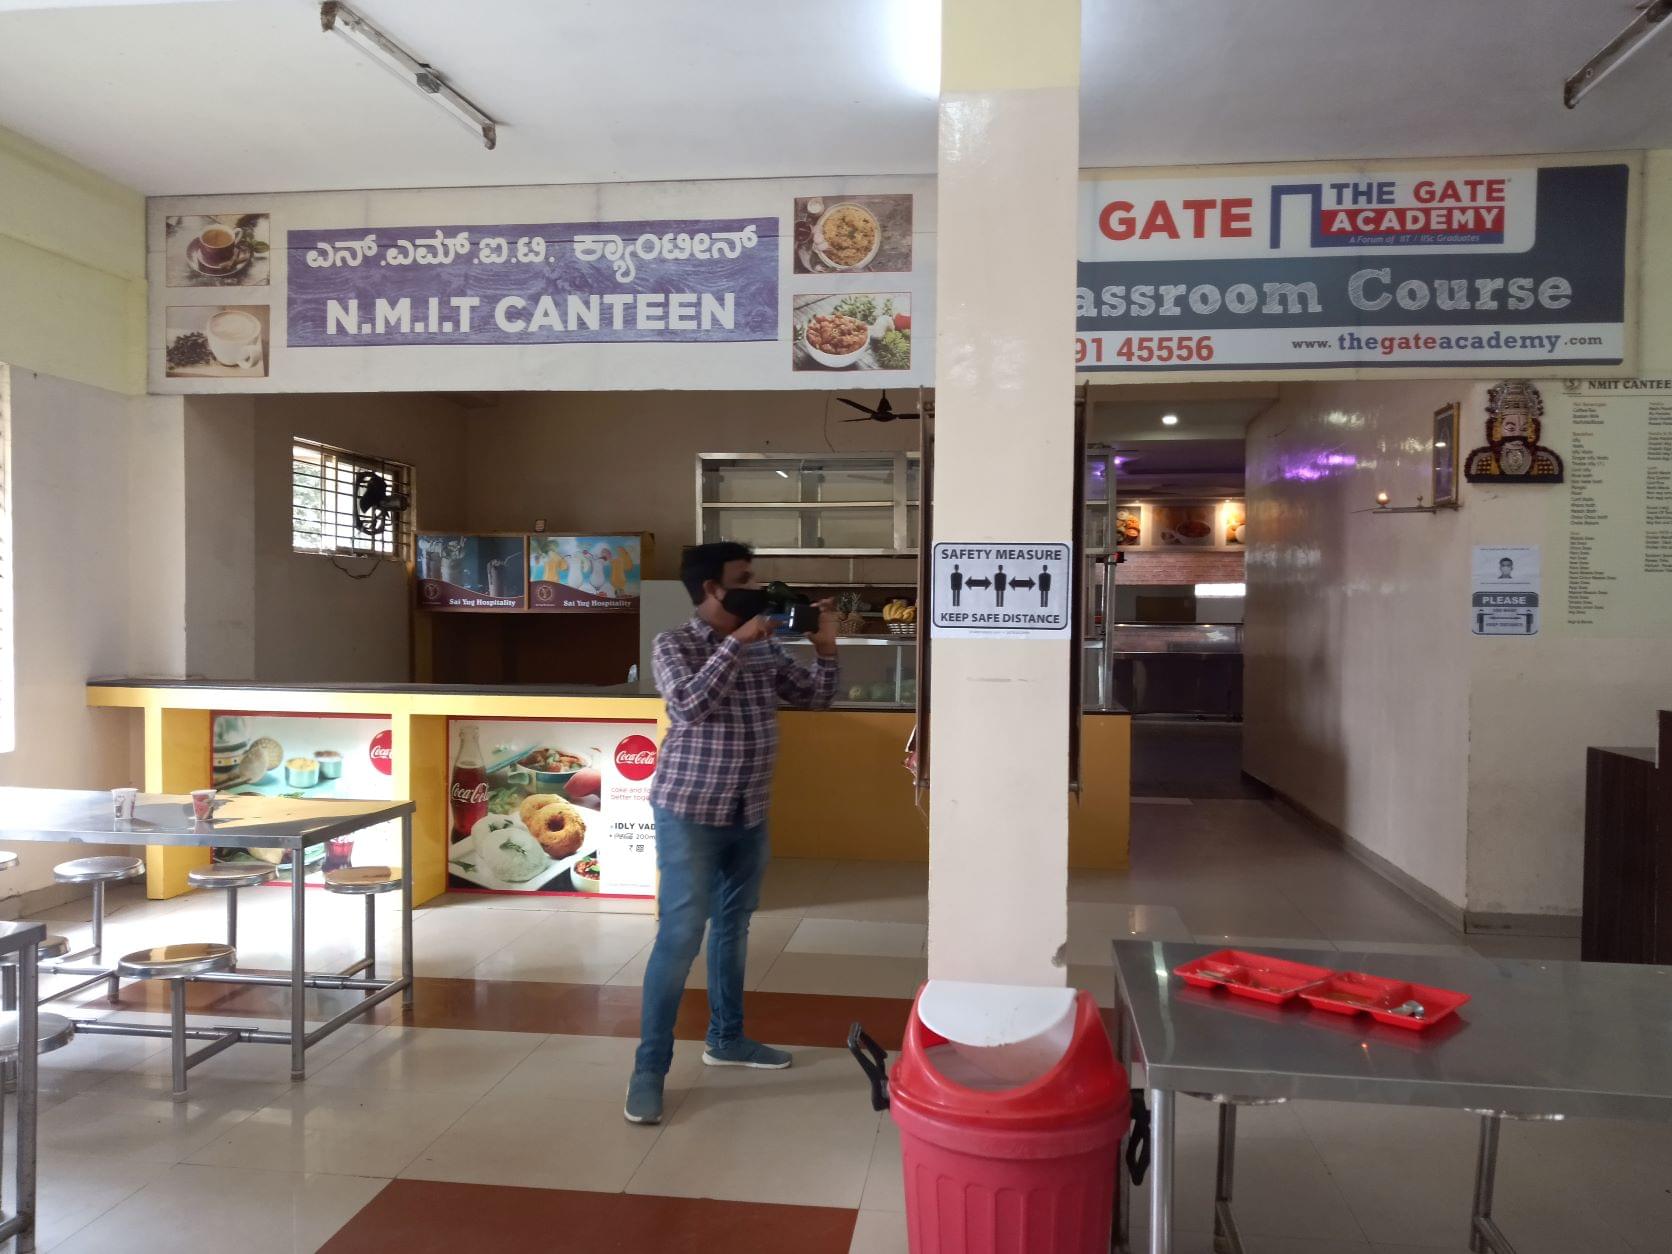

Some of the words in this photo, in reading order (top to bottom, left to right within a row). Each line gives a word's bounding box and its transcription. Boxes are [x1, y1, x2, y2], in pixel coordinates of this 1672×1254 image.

[1330, 182, 1396, 206] THE
[1412, 178, 1506, 204] GATE
[1099, 198, 1253, 241] GATE
[1330, 208, 1499, 232] ACADEMY
[1357, 235, 1384, 244] Forum
[1387, 235, 1394, 245] of
[1437, 233, 1480, 243] Graduates
[1346, 267, 1574, 311] Course
[325, 297, 480, 335] N.M.I.T
[494, 293, 736, 333] CANTEEN
[1116, 336, 1214, 363] 45556
[1588, 380, 1620, 390] NMIT
[941, 548, 992, 560] SAFETY
[995, 549, 1062, 560] MEASURE
[449, 598, 461, 606] Sai
[476, 598, 516, 608] Hospitality
[563, 600, 575, 608] Sai
[591, 599, 632, 609] Hospitality
[1482, 596, 1527, 605] PLEASE
[940, 612, 969, 622] KEEP
[971, 613, 1000, 623] SAFE
[1002, 614, 1060, 624] DISTANCE
[614, 822, 635, 830] IDLY
